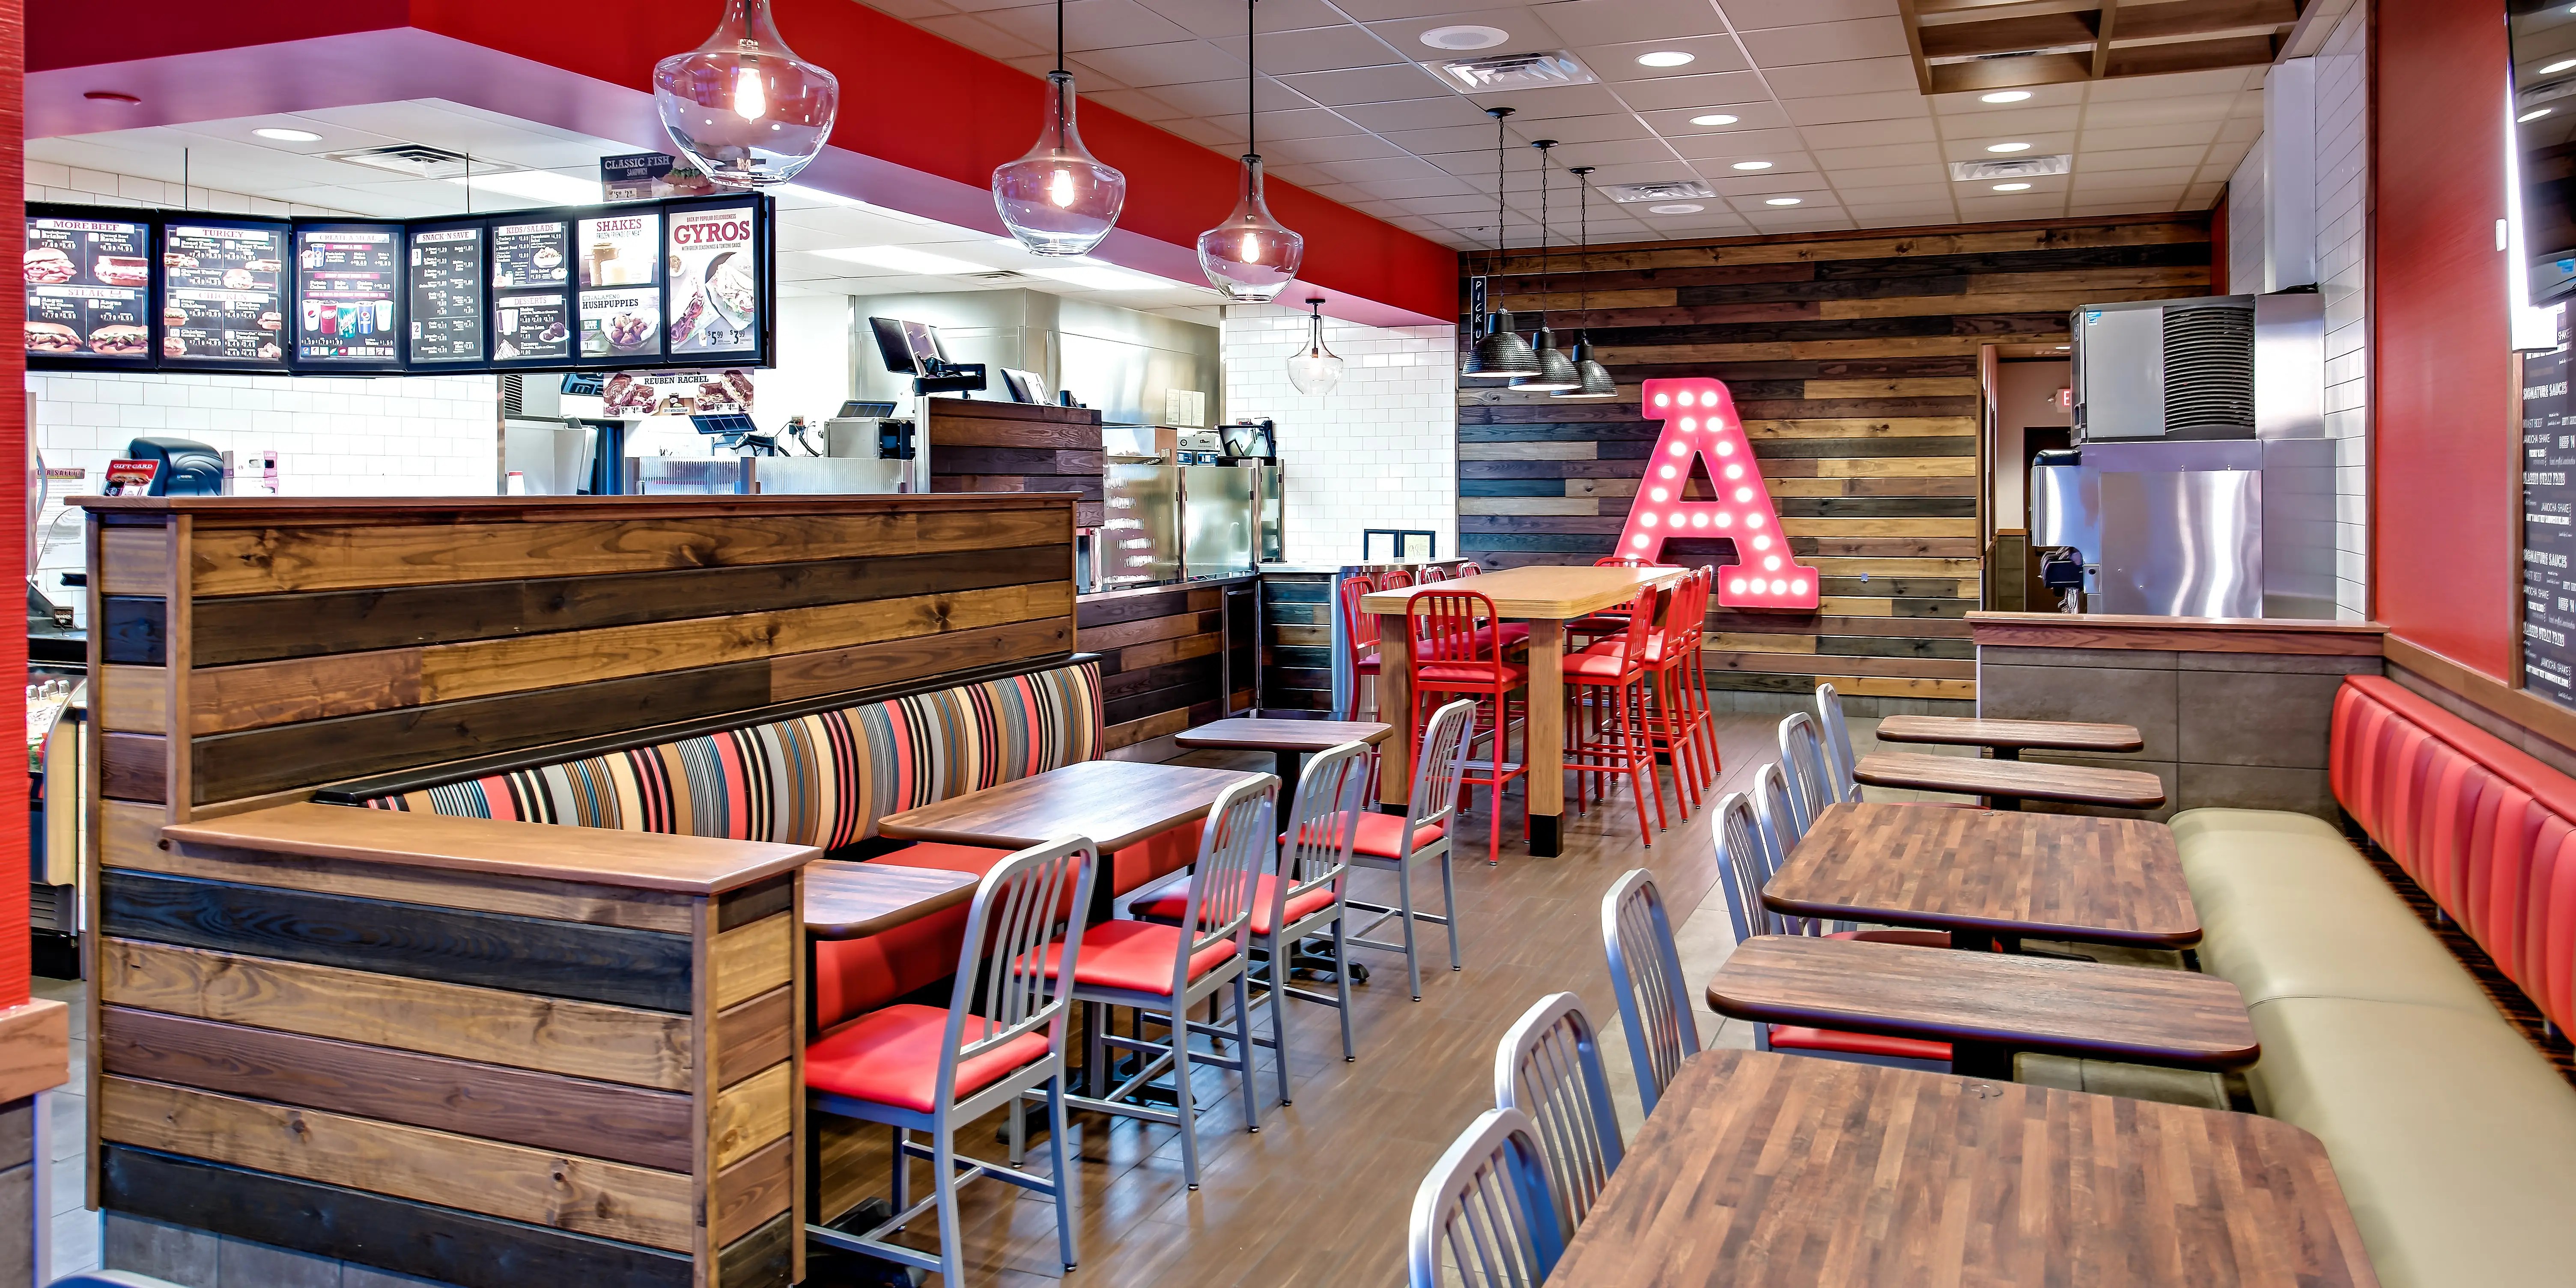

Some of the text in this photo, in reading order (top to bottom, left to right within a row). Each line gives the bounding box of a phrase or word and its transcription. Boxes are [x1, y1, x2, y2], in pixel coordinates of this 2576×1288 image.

[605, 155, 670, 170] CLASSIC FISH
[626, 167, 647, 177] SANDWICH
[53, 221, 119, 231] MORE BEEF
[597, 219, 641, 232] SHAKES
[203, 229, 244, 238] TURKEY
[674, 221, 750, 244] GYROS
[69, 289, 104, 297] STEAK
[199, 292, 247, 300] CHICKEN
[582, 299, 638, 309] HUSHPUPPIES
[1475, 330, 1482, 344] U
[2558, 328, 2569, 341] SHAKE
[2523, 381, 2568, 400] SIGNATURE SAUCES
[2523, 417, 2543, 428] OAST BEEF
[2539, 434, 2551, 443] SHAKE
[2553, 472, 2565, 486] FRIES
[1612, 377, 1819, 609] A
[2541, 502, 2569, 513] JAMOCHA SHAKE
[1409, 544, 1420, 558] 98
[2549, 553, 2567, 569] SAUCES
[2538, 588, 2550, 600] SHAKE
[2552, 629, 2565, 647] FRIES
[2540, 657, 2569, 676] JAMOCHA SHAKE
